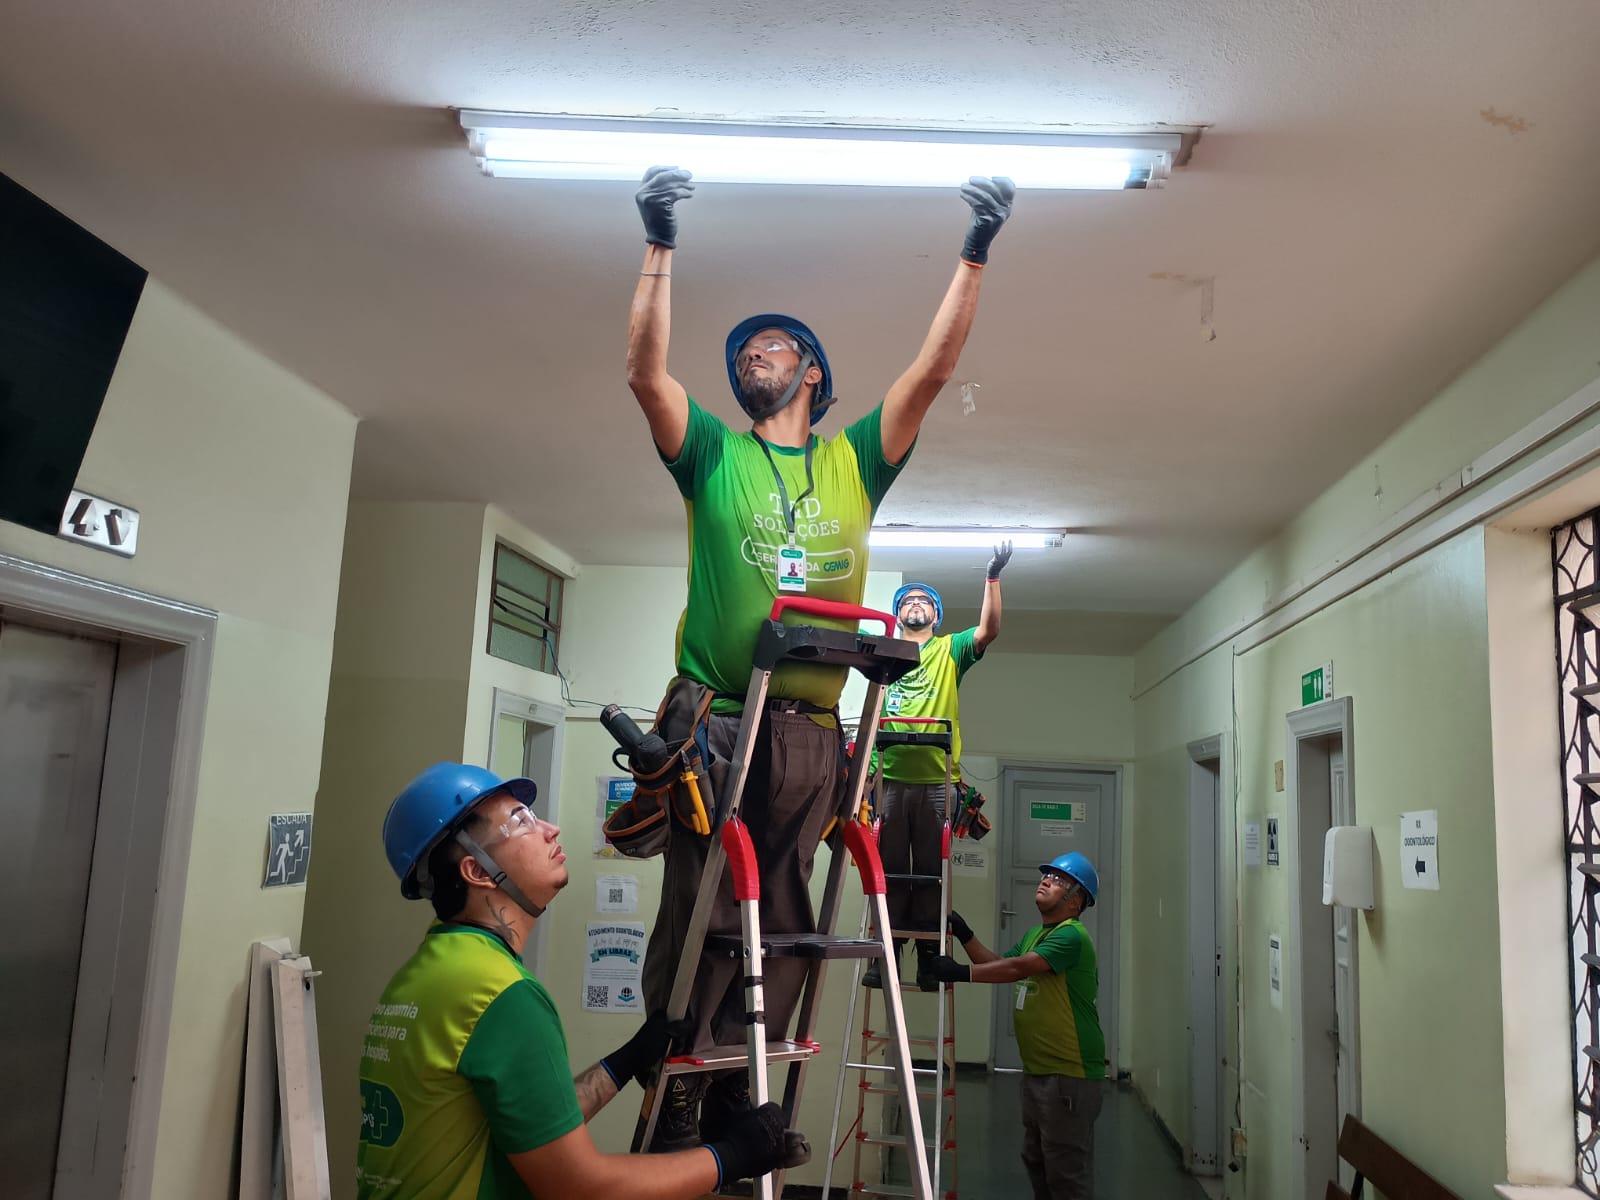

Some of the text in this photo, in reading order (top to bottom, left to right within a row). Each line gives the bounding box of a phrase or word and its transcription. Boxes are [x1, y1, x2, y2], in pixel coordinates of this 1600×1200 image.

[753, 514, 840, 541] SOLÇÕES
[823, 559, 850, 572] CEMIG
[276, 814, 308, 825] ESCADA
